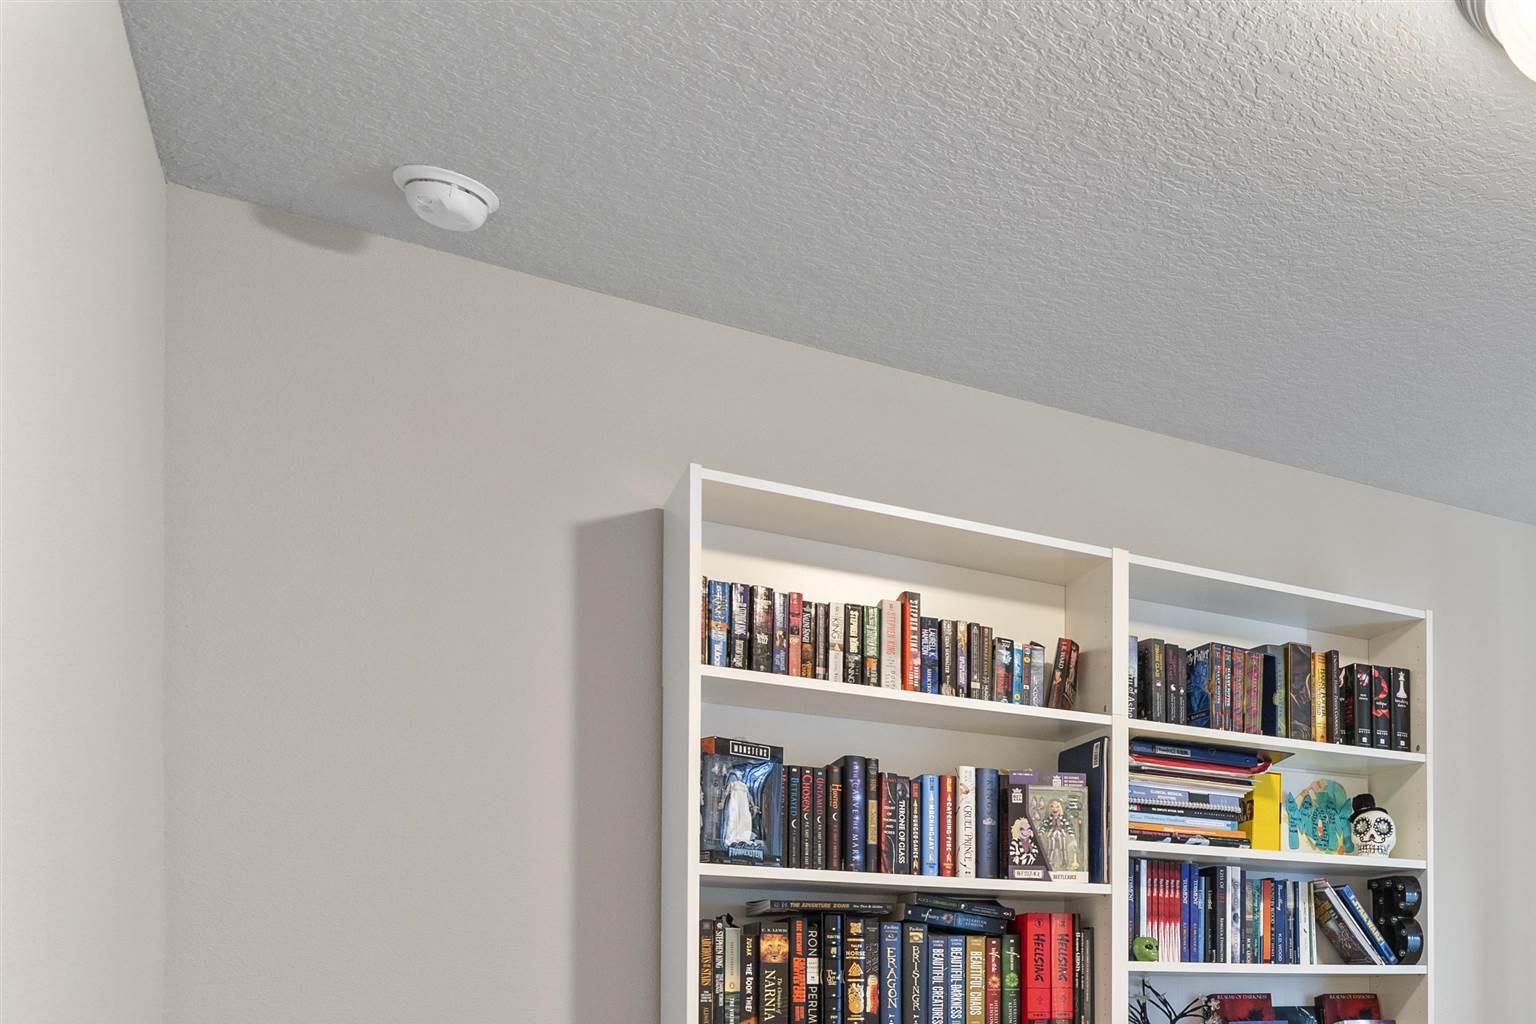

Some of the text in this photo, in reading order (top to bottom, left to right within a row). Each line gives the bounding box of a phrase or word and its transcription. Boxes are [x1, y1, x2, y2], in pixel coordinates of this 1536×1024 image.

[832, 616, 841, 639] KING
[887, 611, 897, 656] STEPHEN KING
[909, 599, 918, 653] STEPHEN KING
[733, 742, 768, 758] MONSTERS
[791, 777, 800, 816] BETRAYED
[802, 774, 813, 812] CHOSEN
[816, 777, 825, 815] UNTAMED
[898, 800, 906, 864] THRONE OF GLASS
[963, 805, 973, 862] CRUEL PRINCE
[715, 930, 724, 968] STEPHEN KING
[808, 930, 817, 956] RON
[1033, 933, 1046, 982] HELLSING
[1057, 933, 1069, 982] HELLSING
[745, 963, 754, 1013] THE BOOK THIEF
[763, 969, 776, 1021] NARNIA
[886, 947, 898, 1008] ERAGON
[911, 945, 920, 1011] BRISINGR
[932, 948, 944, 1024] BEAUTIFUL CREATURES
[950, 946, 962, 1019] BEAUTIFUL DARKNESS
[970, 951, 982, 1016] BEAUTIFUL CHAOS
